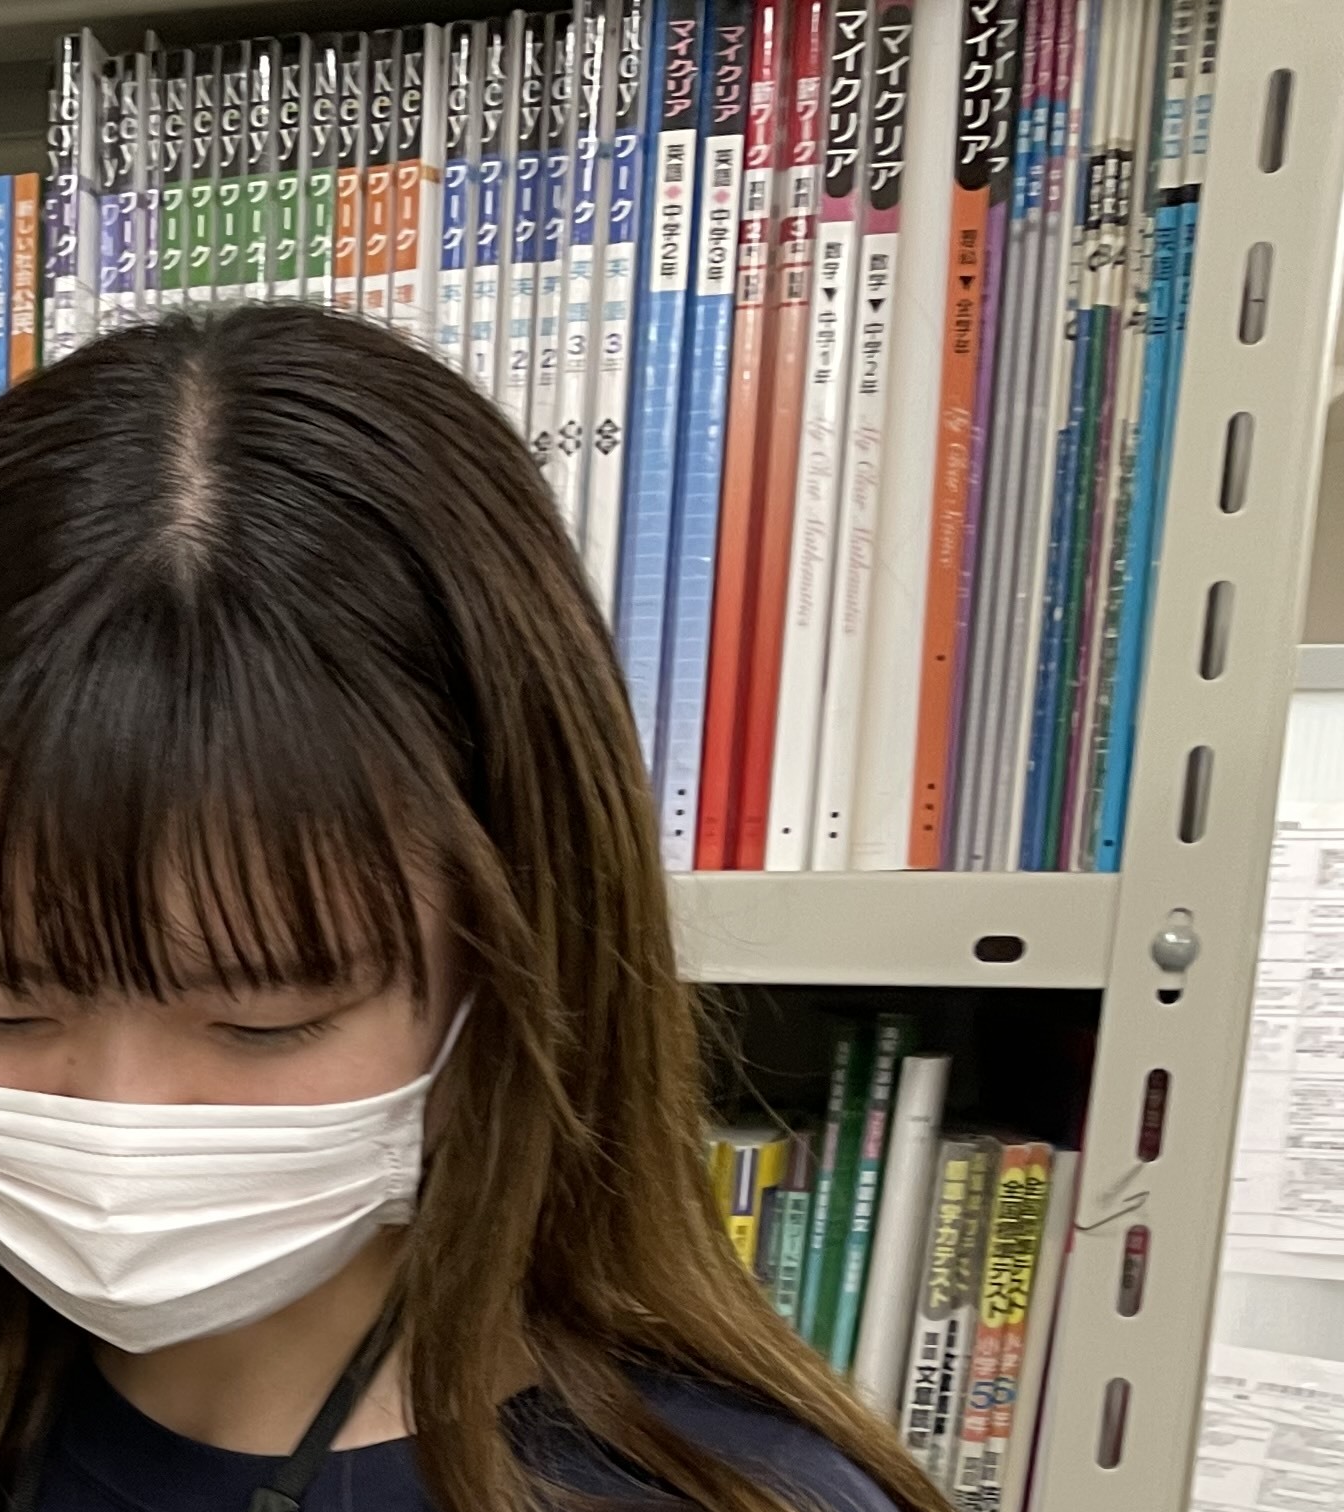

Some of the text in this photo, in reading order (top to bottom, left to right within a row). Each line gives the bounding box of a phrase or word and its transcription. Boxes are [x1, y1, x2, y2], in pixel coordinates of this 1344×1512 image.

[665, 20, 698, 117] マイクリア
[715, 26, 745, 123] マイクリア
[827, 11, 867, 178] マイクリア
[869, 25, 911, 191] マイクリア
[748, 81, 775, 165] 新ワーク
[794, 77, 820, 164] 新ワーク
[277, 178, 298, 260] ワーク
[311, 174, 331, 258] ワーク
[337, 175, 358, 258] ワーク
[367, 172, 390, 256] ワーク
[397, 167, 419, 250] ワーク
[444, 165, 467, 250] ワーク
[477, 160, 500, 246] ワーク
[516, 157, 539, 243] ワーク
[611, 134, 636, 222] ワーク
[163, 189, 182, 270] ワーク
[190, 185, 212, 268] ワーク
[219, 183, 240, 267] ワーク
[247, 180, 269, 263] ワーク
[660, 205, 681, 278] 中学2年
[707, 209, 730, 280] 中学3年
[11, 200, 35, 335] 新しい社会 公民
